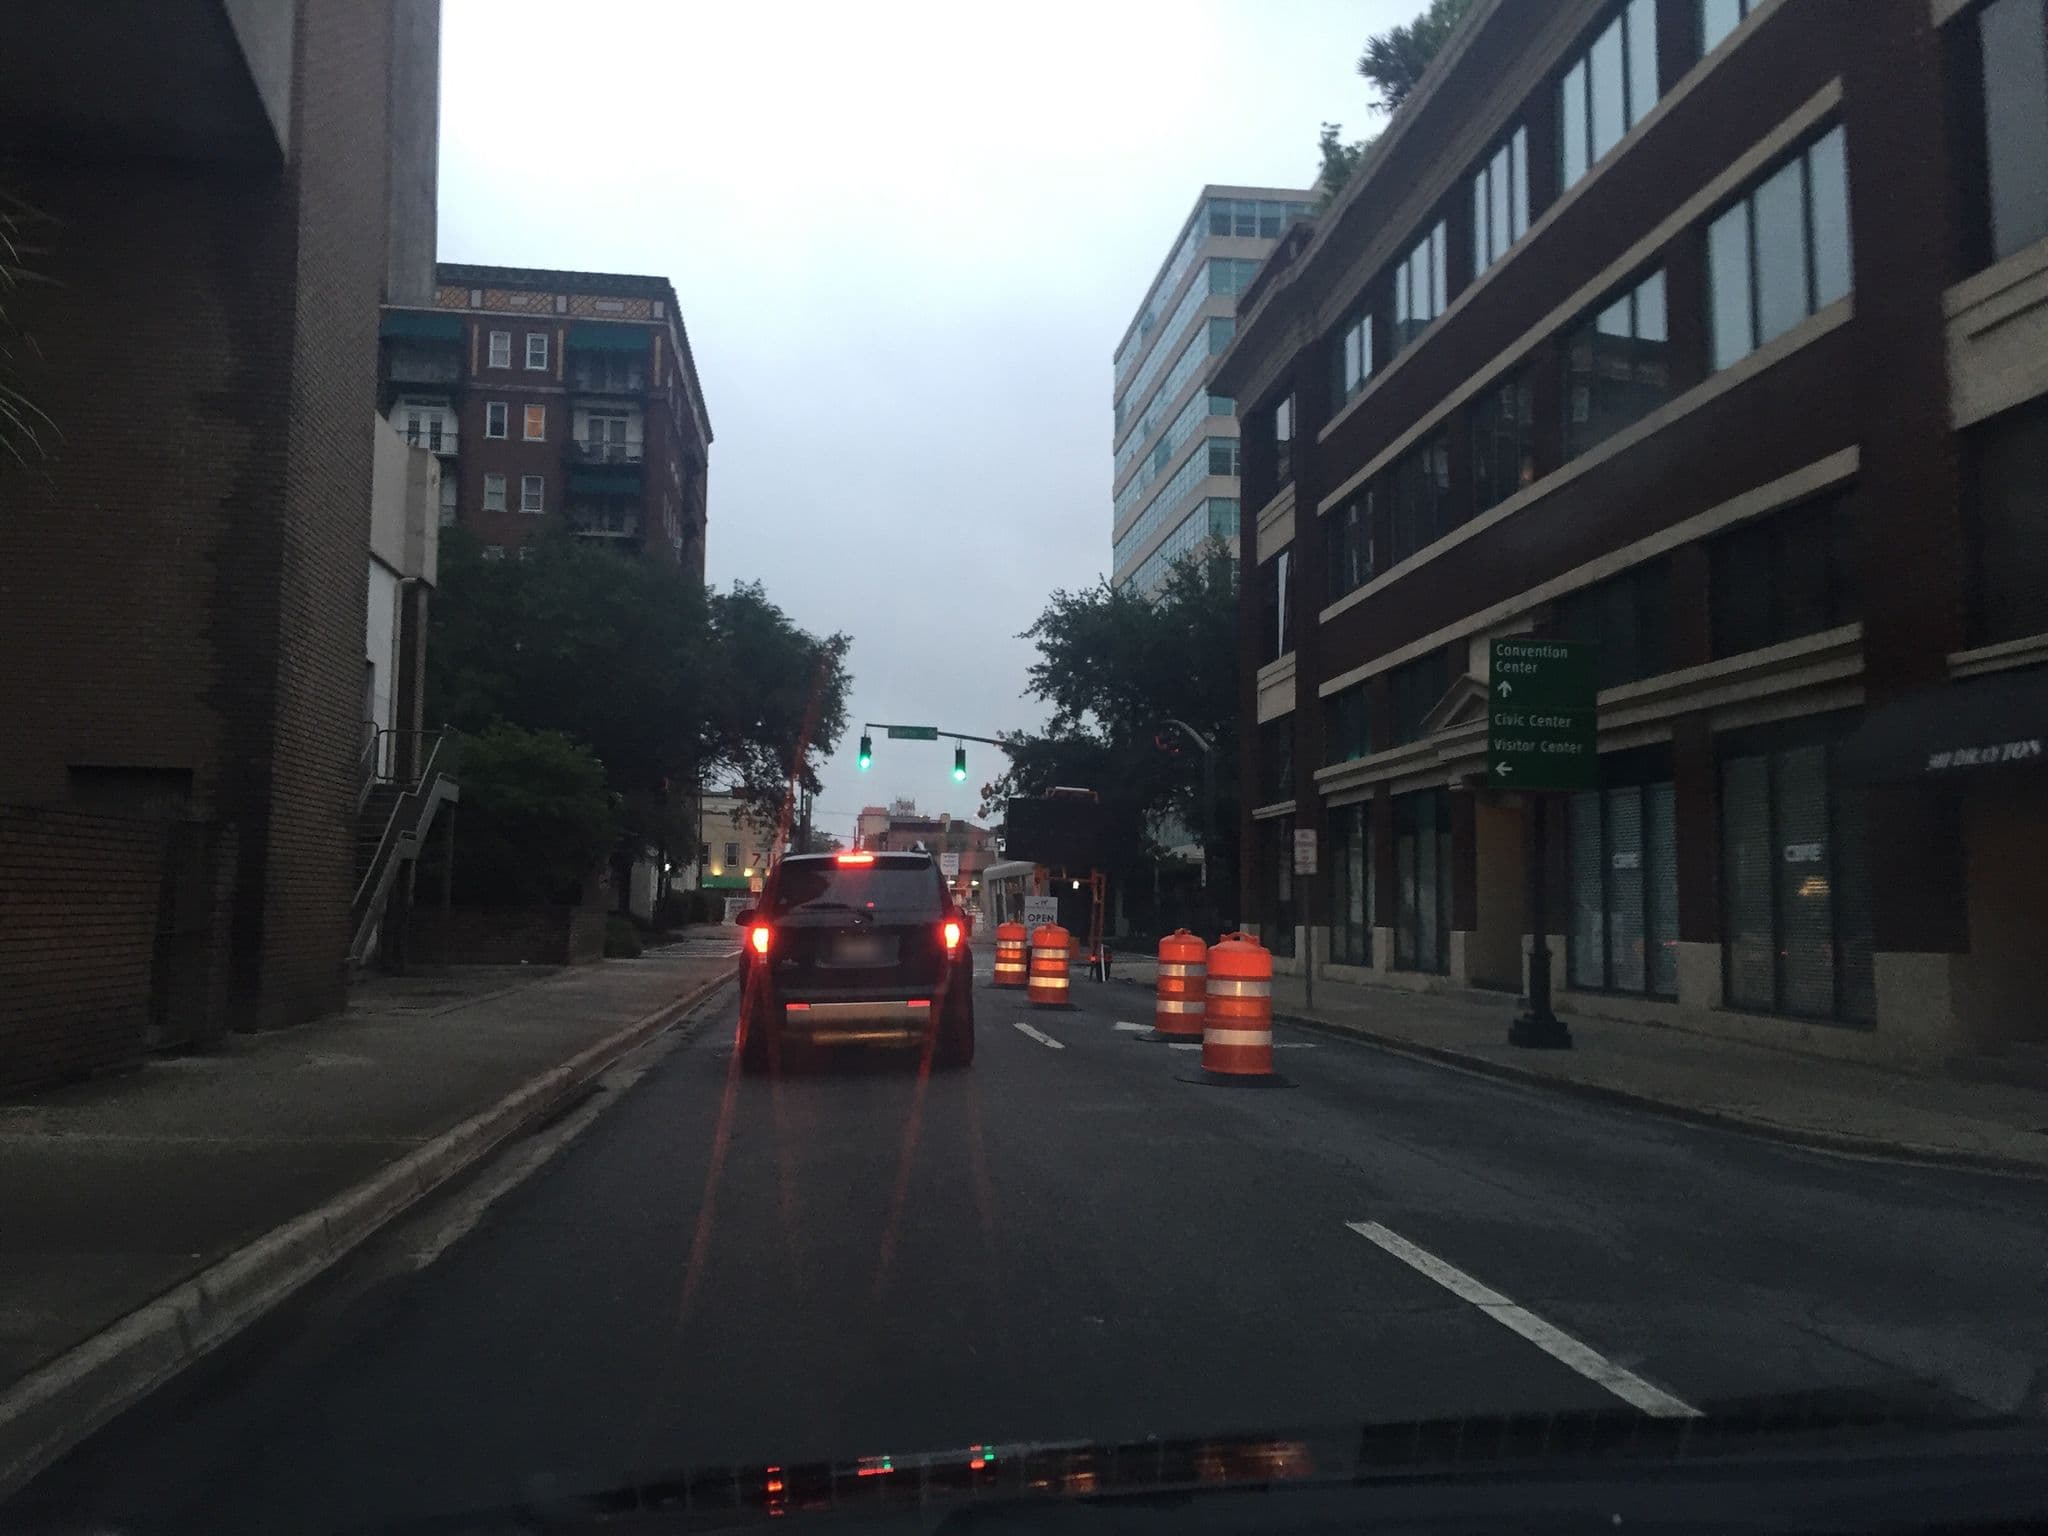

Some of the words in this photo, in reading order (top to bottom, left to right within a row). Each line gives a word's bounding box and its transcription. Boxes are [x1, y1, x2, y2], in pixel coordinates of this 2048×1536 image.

[1495, 644, 1568, 658] Convention
[1495, 661, 1538, 673] Center
[1494, 713, 1525, 726] Civic
[1529, 715, 1571, 728] Center
[1494, 739, 1535, 751] Visitor
[1540, 741, 1582, 755] Center
[1028, 913, 1054, 922] OPEN
